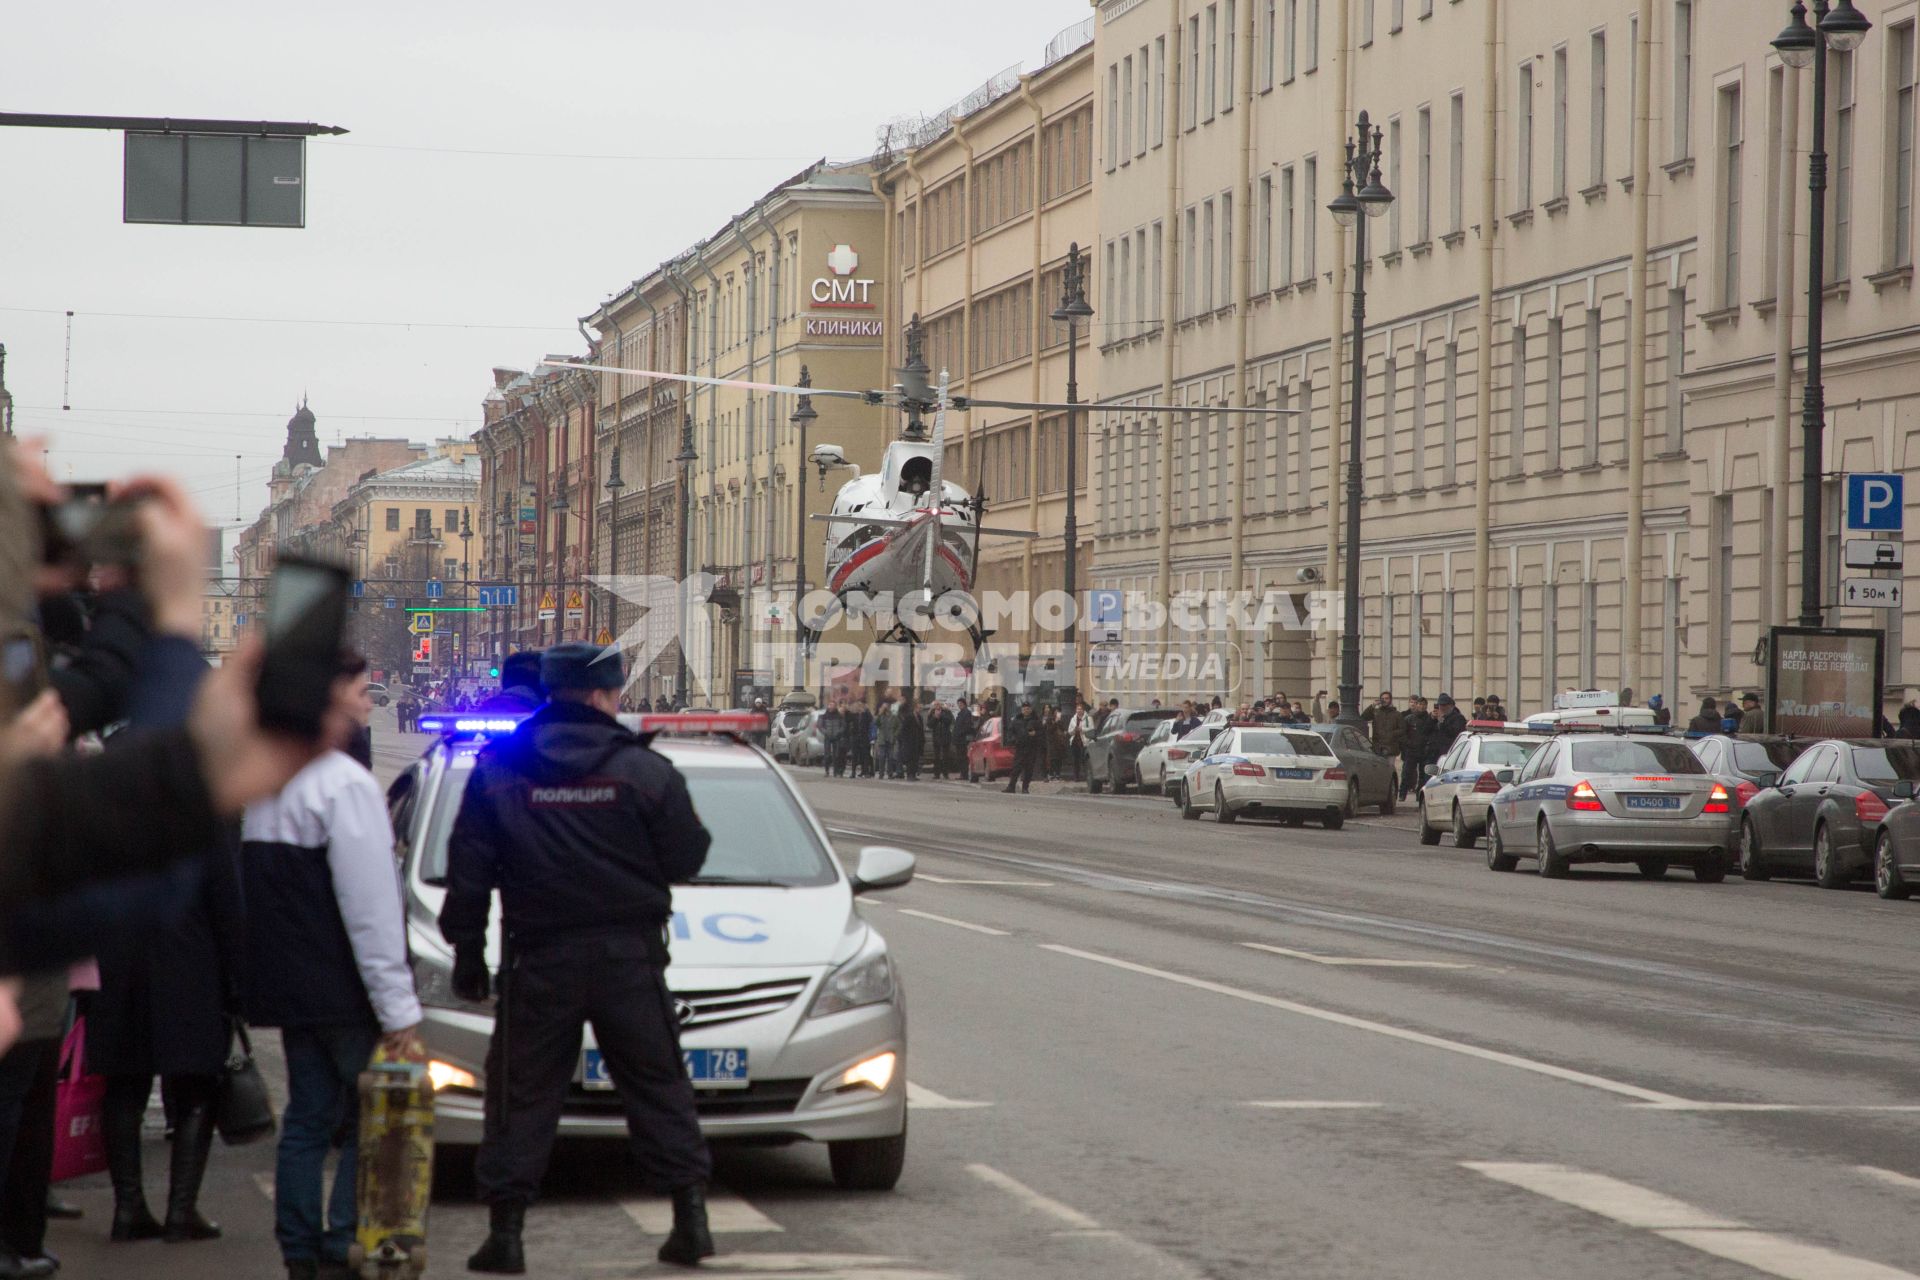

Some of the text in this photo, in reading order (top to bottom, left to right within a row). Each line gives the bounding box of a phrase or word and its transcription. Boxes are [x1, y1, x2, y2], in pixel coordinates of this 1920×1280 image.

[811, 278, 875, 303] СМТ
[806, 320, 883, 336] КЛИНИКИ
[1863, 480, 1893, 524] P
[1862, 588, 1886, 599] 50м
[1782, 650, 1808, 661] КАРТА
[1809, 651, 1855, 662] РАССРОЧКИ
[1782, 660, 1870, 673] ВСЕГДА БЕЗ ПЕРЕПЛАТ
[532, 787, 615, 803] ПОЛИЦИЯ
[1640, 798, 1664, 807] 0400
[711, 1051, 738, 1072] 78
